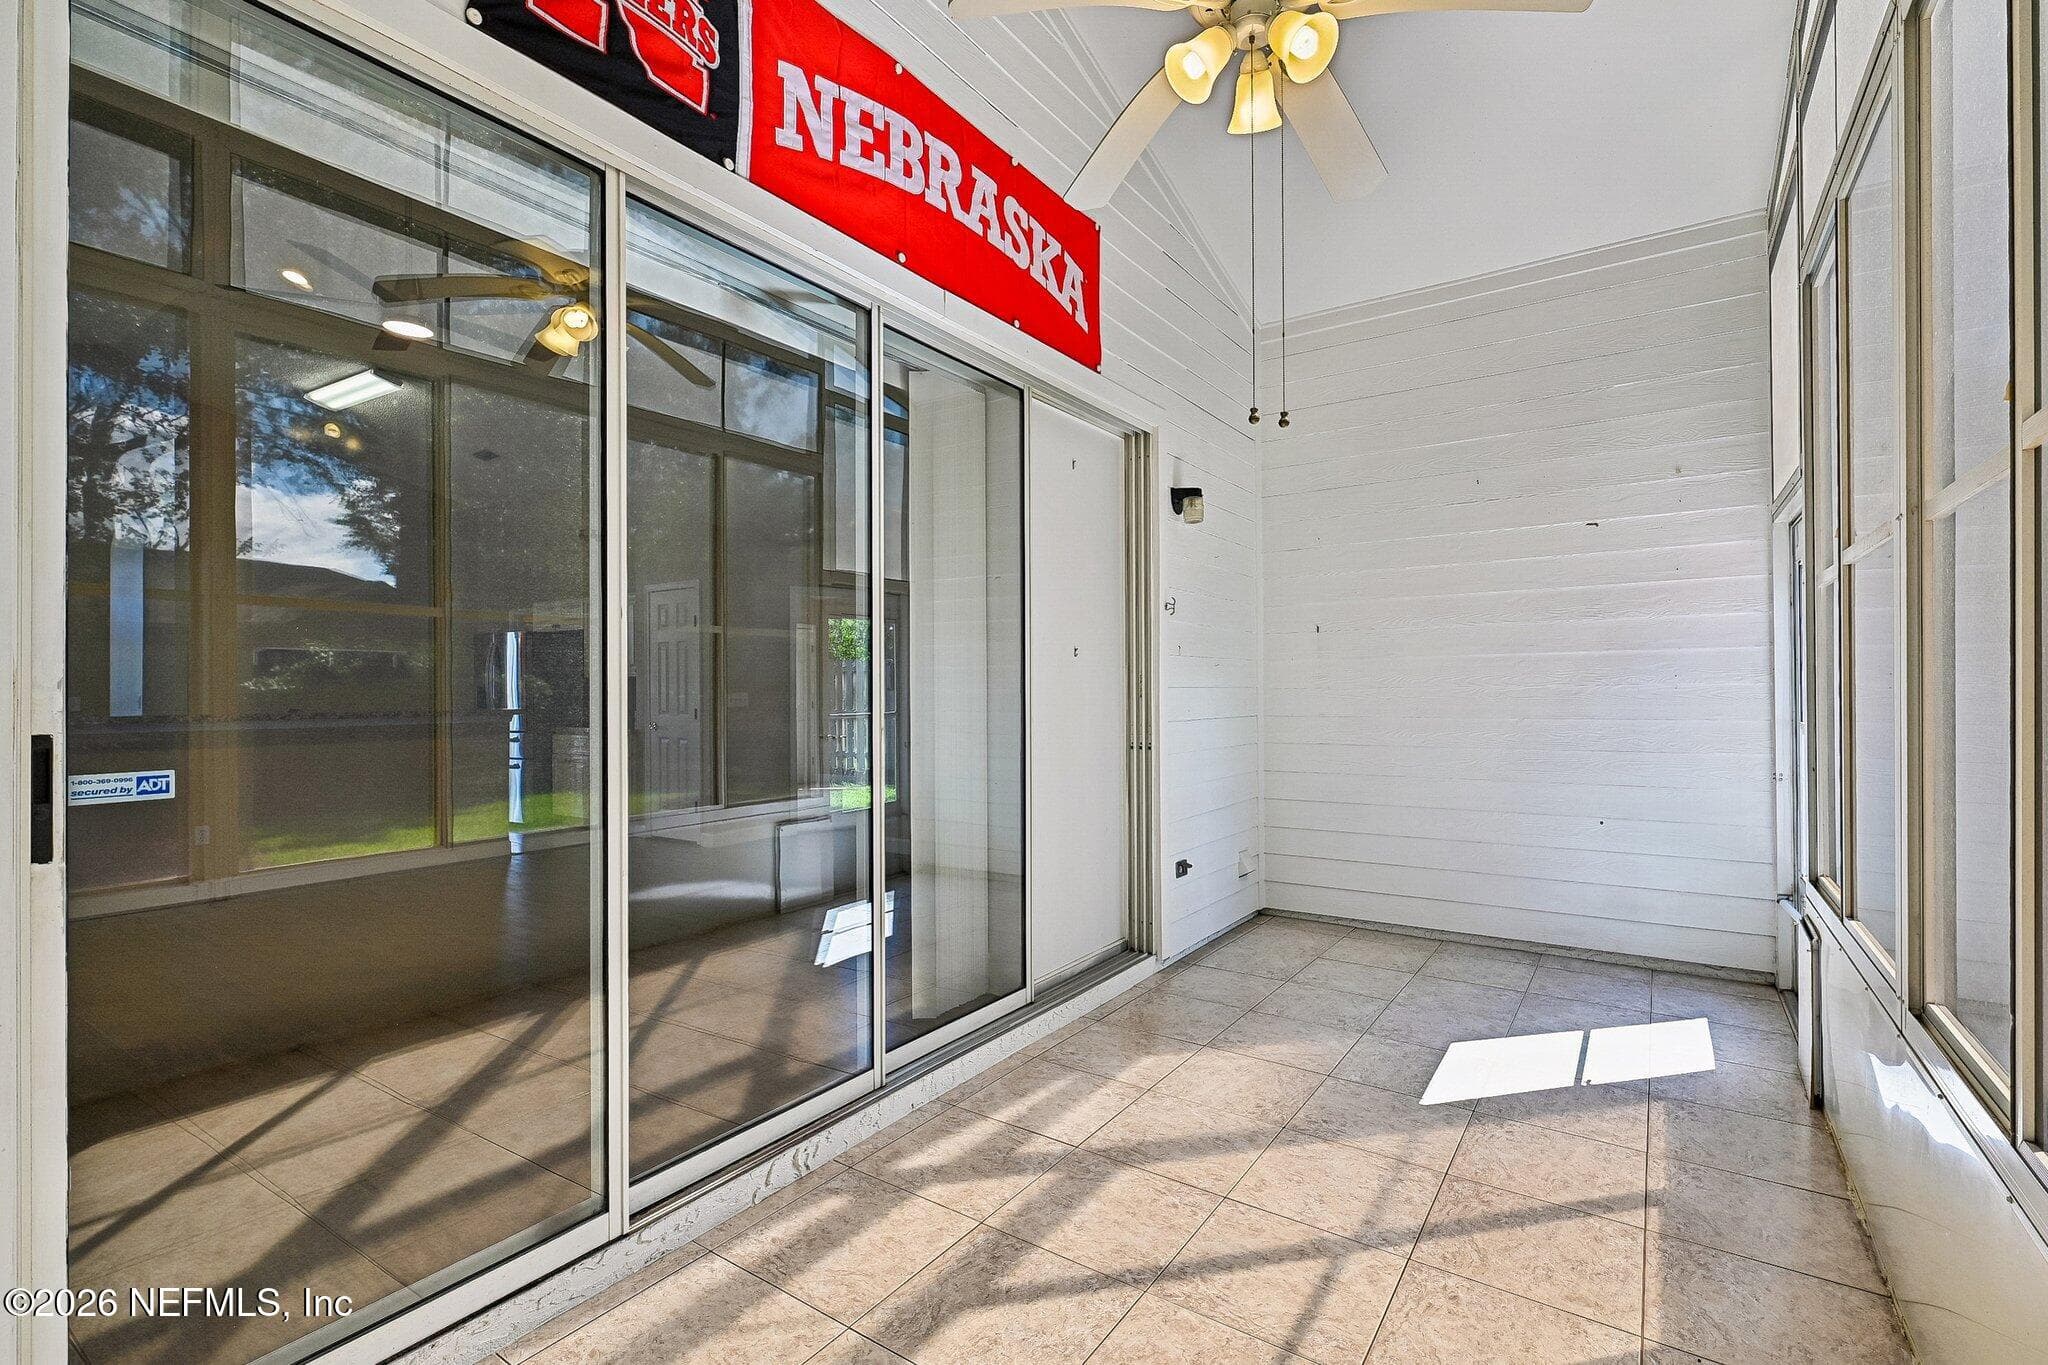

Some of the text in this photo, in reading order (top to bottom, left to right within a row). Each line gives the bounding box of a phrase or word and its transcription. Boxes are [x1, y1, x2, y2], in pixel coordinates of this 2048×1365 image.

[622, 0, 720, 69] ERS
[775, 60, 1089, 334] NEBRASKA
[70, 786, 133, 797] secured by
[136, 776, 170, 793] ADT
